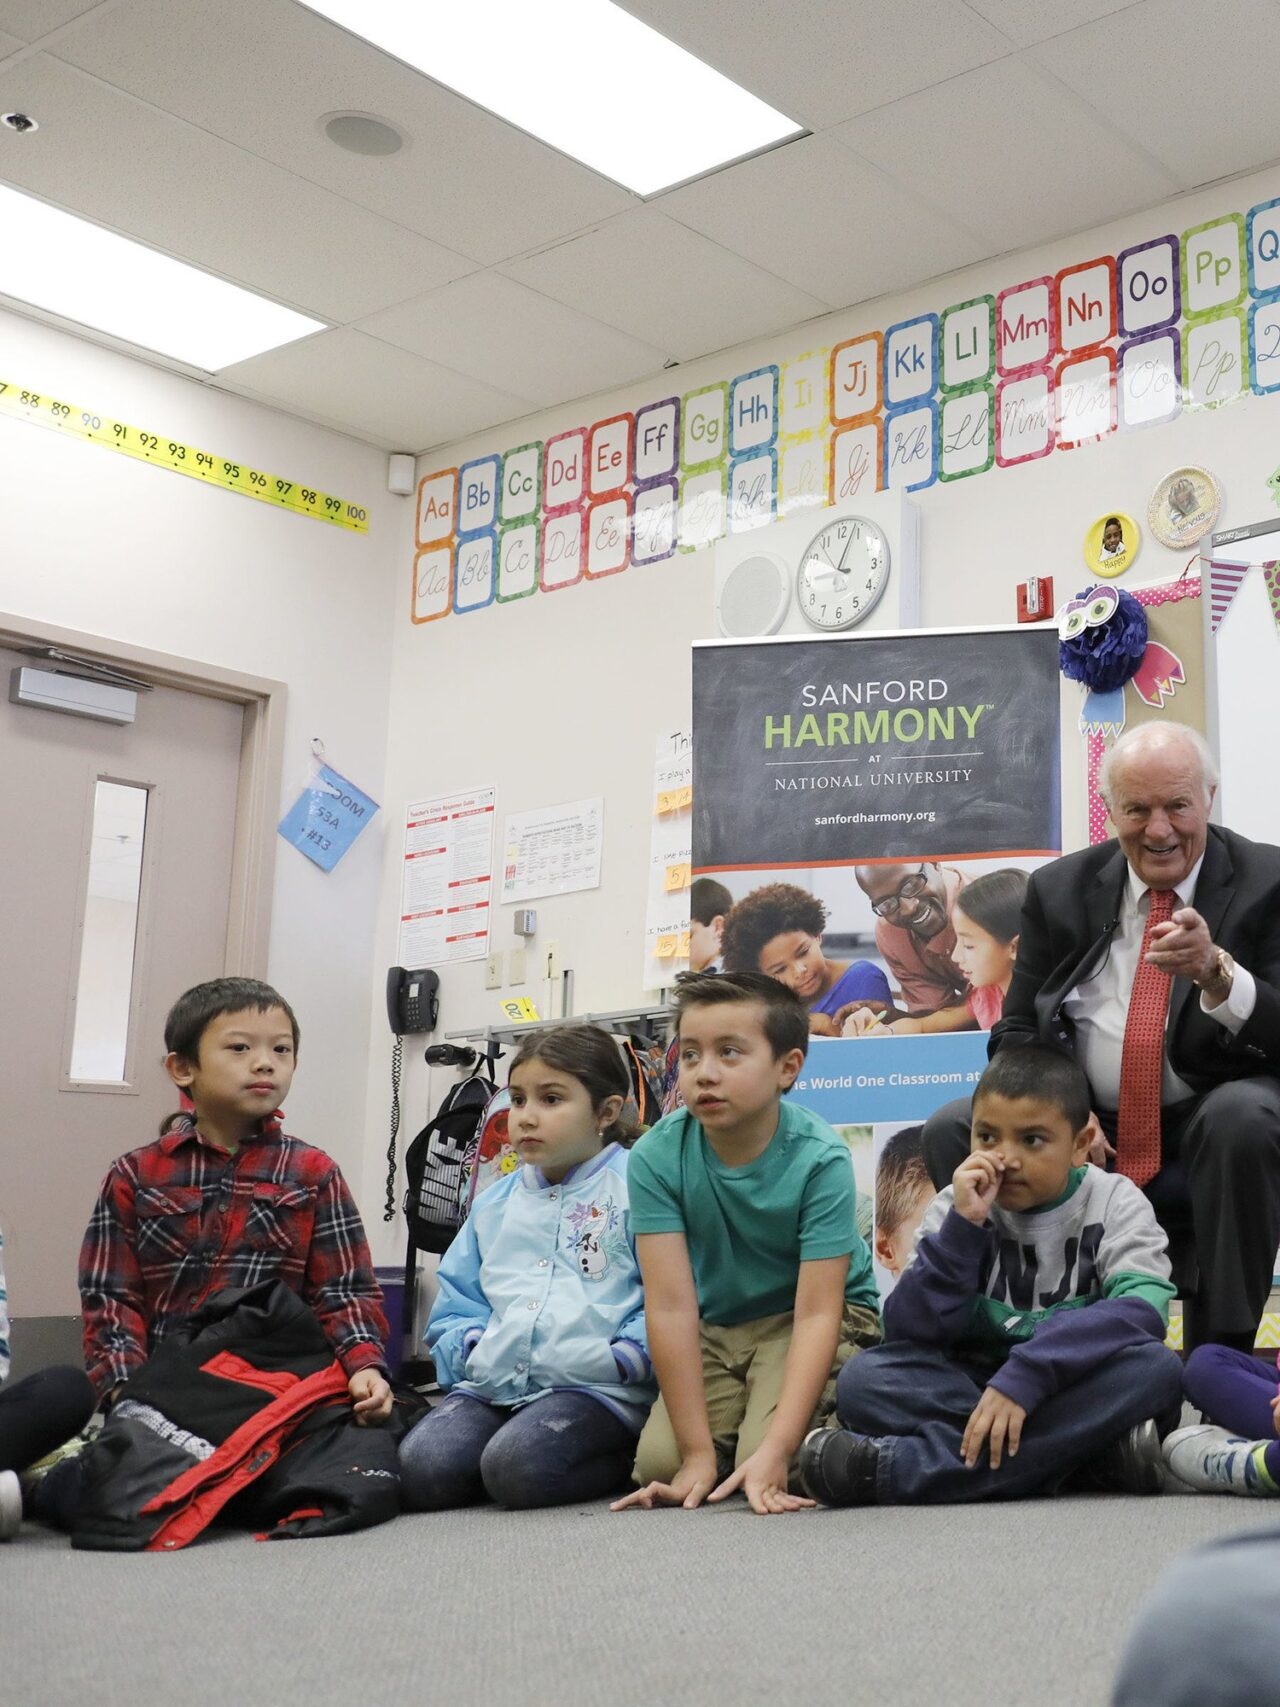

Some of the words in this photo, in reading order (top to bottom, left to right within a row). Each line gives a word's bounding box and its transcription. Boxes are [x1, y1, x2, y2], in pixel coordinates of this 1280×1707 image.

[424, 497, 449, 522] Aa
[467, 482, 490, 510] Bb
[508, 470, 533, 496] Cc
[551, 454, 578, 486] Dd
[597, 443, 622, 472] Ee
[644, 423, 668, 455] Ff
[690, 414, 719, 443] Gg
[739, 395, 768, 427] Hh
[844, 360, 867, 396] Jj
[895, 344, 925, 378] Kk
[1003, 313, 1048, 346] Mm
[1068, 292, 1102, 326] Nn
[1130, 271, 1167, 301] Oo
[1196, 250, 1231, 286] Pp
[19, 390, 40, 409] 88
[50, 401, 71, 419] 89
[81, 412, 101, 431] 90
[113, 424, 127, 440] 91
[139, 433, 158, 450] 92
[168, 443, 187, 460] 93
[195, 453, 214, 469] 94
[223, 462, 240, 479] 95
[249, 471, 267, 488] 96
[276, 480, 293, 496] 97
[300, 489, 317, 506] 98
[325, 497, 342, 513] 99
[347, 504, 366, 522] 100
[837, 526, 847, 539] 12
[870, 557, 878, 570] 3
[1103, 555, 1126, 570] Happy
[865, 579, 873, 591] 4
[809, 593, 816, 606] 8
[852, 596, 859, 609] 5
[821, 604, 827, 617] 7
[835, 606, 842, 619] 6
[802, 678, 948, 707] SANFORD
[764, 704, 985, 748] HARMONY
[868, 755, 881, 763] AT
[774, 774, 862, 791] NATIONAL
[870, 769, 972, 786] UNIVERSITY
[325, 781, 365, 818] OOM
[814, 810, 936, 826] sanfordharmony.org
[810, 1076, 852, 1089] World
[856, 1074, 885, 1087] One
[889, 1072, 962, 1086] Classroom
[966, 1071, 981, 1082] at
